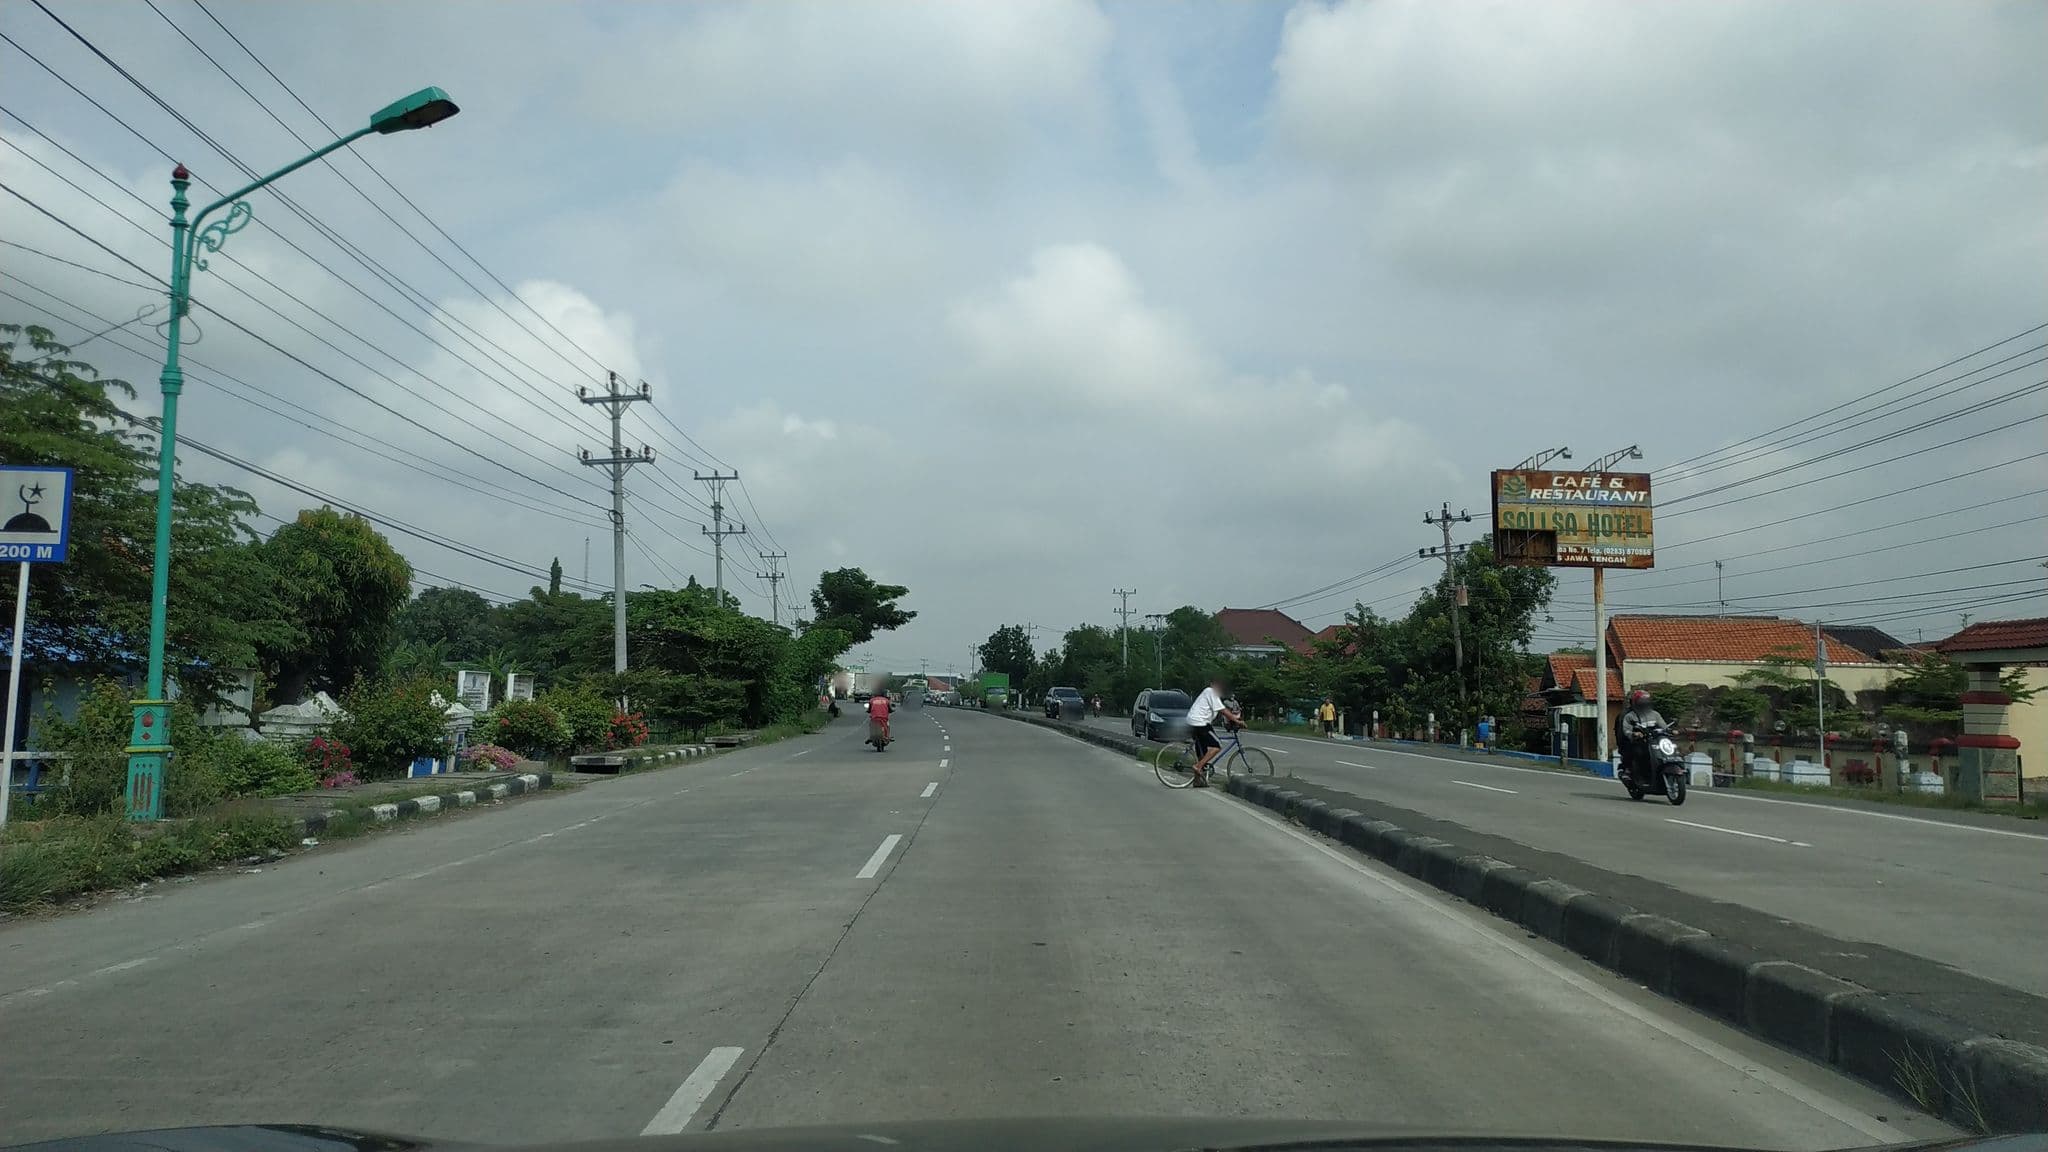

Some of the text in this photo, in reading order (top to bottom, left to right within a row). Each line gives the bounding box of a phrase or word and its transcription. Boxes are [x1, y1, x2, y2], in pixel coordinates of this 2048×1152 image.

[1552, 473, 1625, 489] CAFÉ &
[1530, 488, 1648, 502] RESTAURANT
[1587, 513, 1649, 539] HOTEL
[0, 544, 53, 559] 200 M
[1591, 555, 1626, 563] TENGAH
